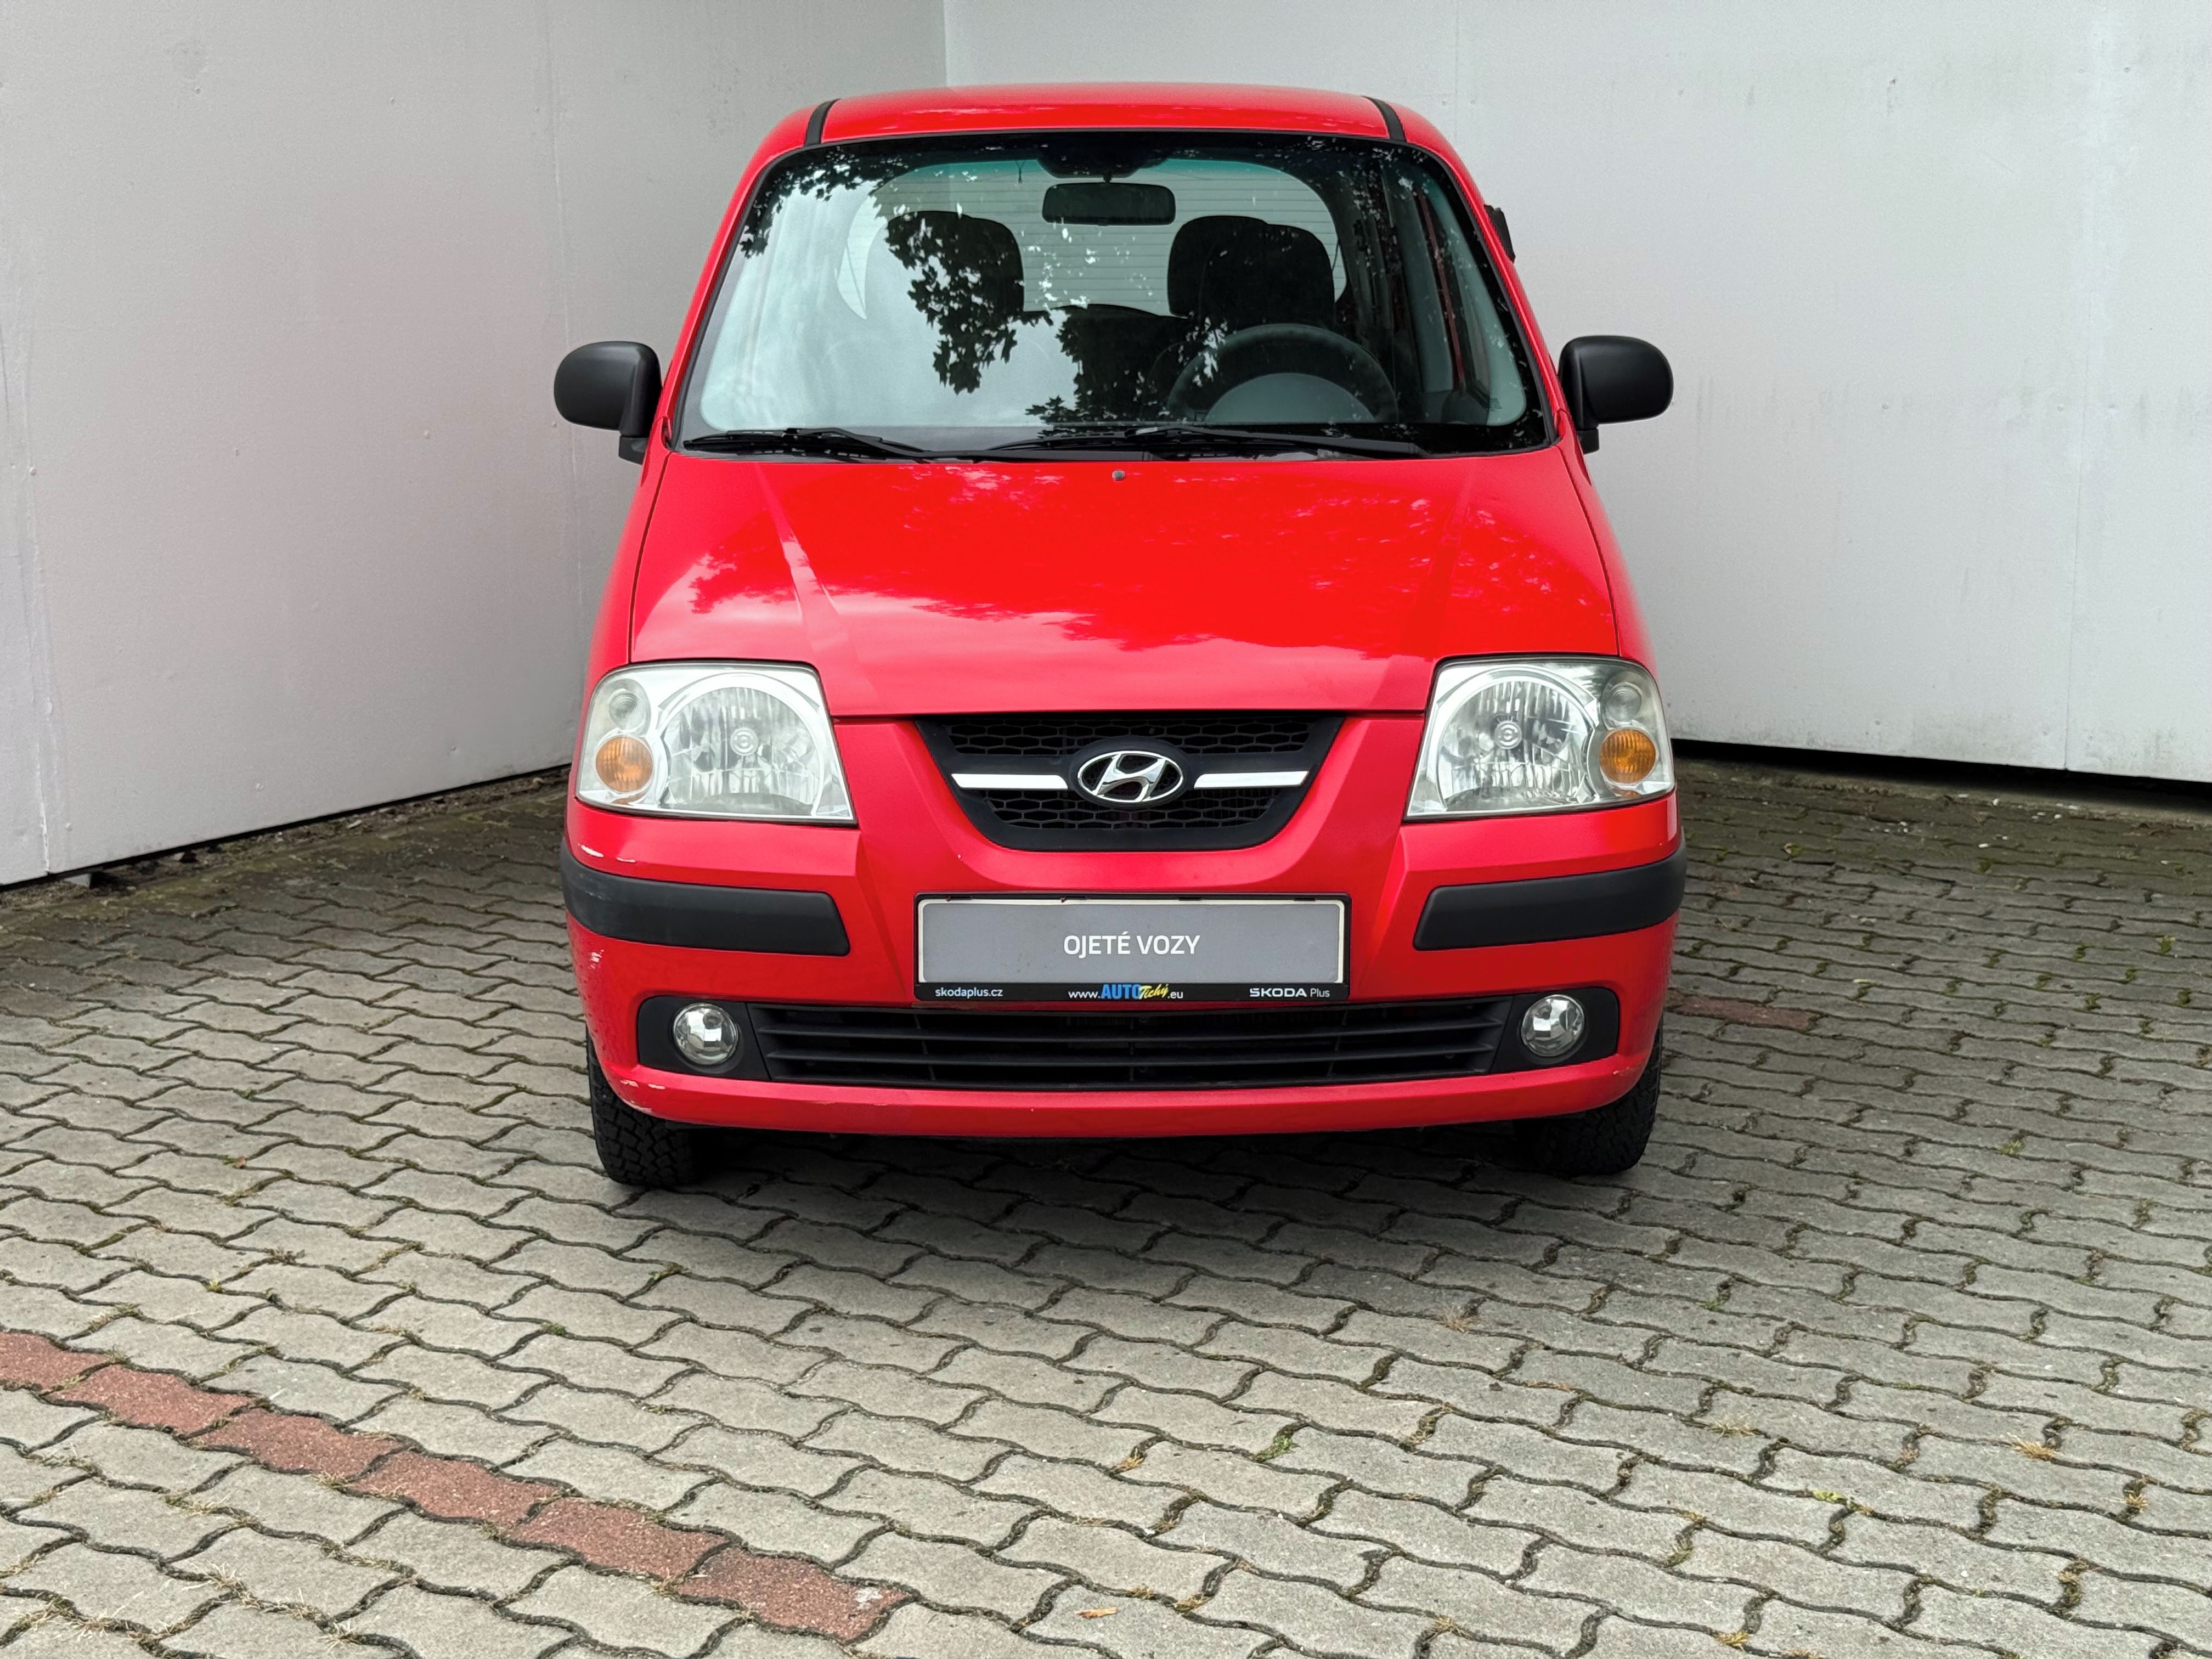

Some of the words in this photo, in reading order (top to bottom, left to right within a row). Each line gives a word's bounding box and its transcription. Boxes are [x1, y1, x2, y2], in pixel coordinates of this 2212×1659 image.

[1064, 931, 1131, 959] OJETÉ
[1136, 935, 1200, 955] VOZY
[935, 987, 1003, 999] skodaplus.cz
[1310, 988, 1330, 997] Plus
